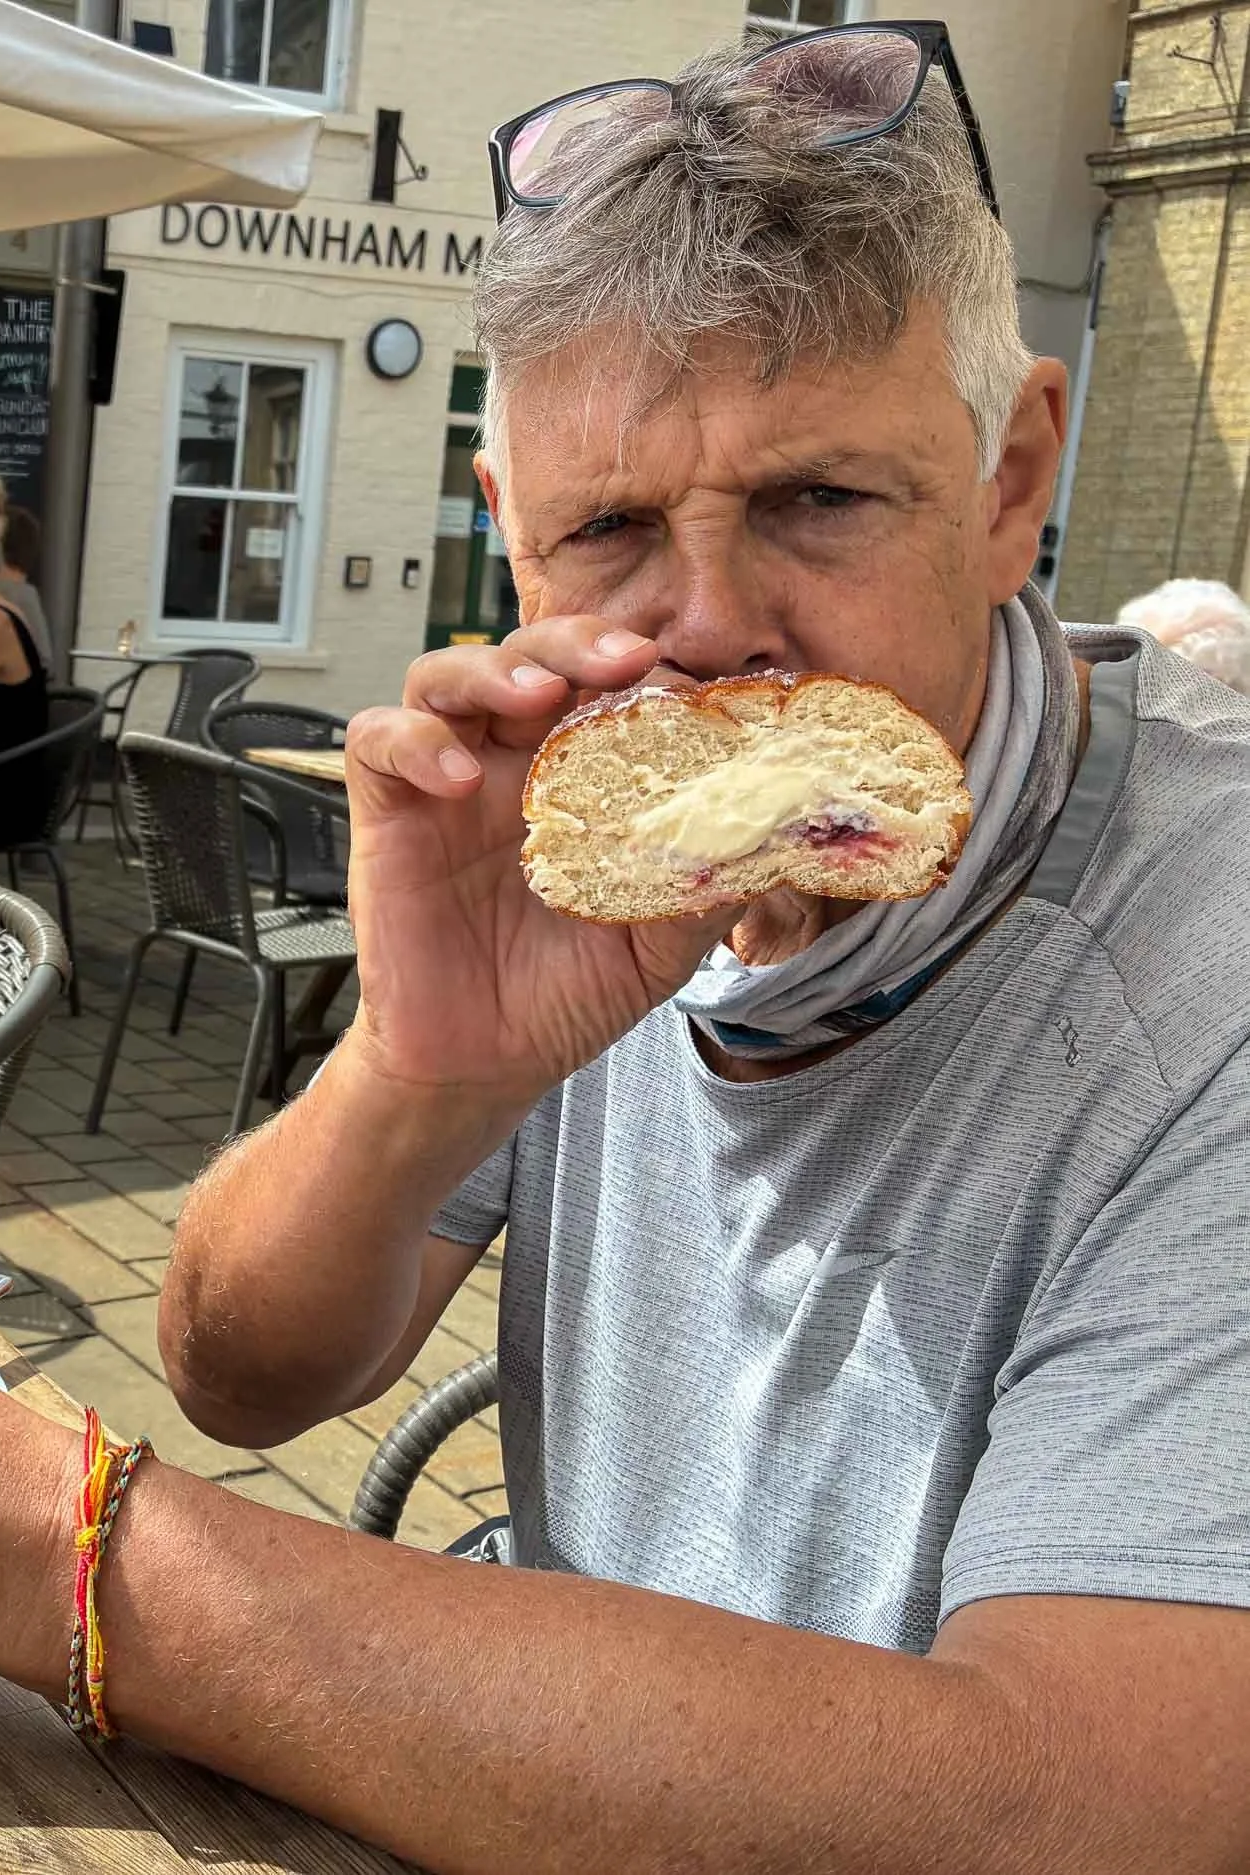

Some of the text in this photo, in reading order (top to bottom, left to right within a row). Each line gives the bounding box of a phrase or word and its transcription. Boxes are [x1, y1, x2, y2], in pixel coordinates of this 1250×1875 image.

[159, 202, 485, 276] DOWNHAM M
[3, 297, 51, 321] THE
